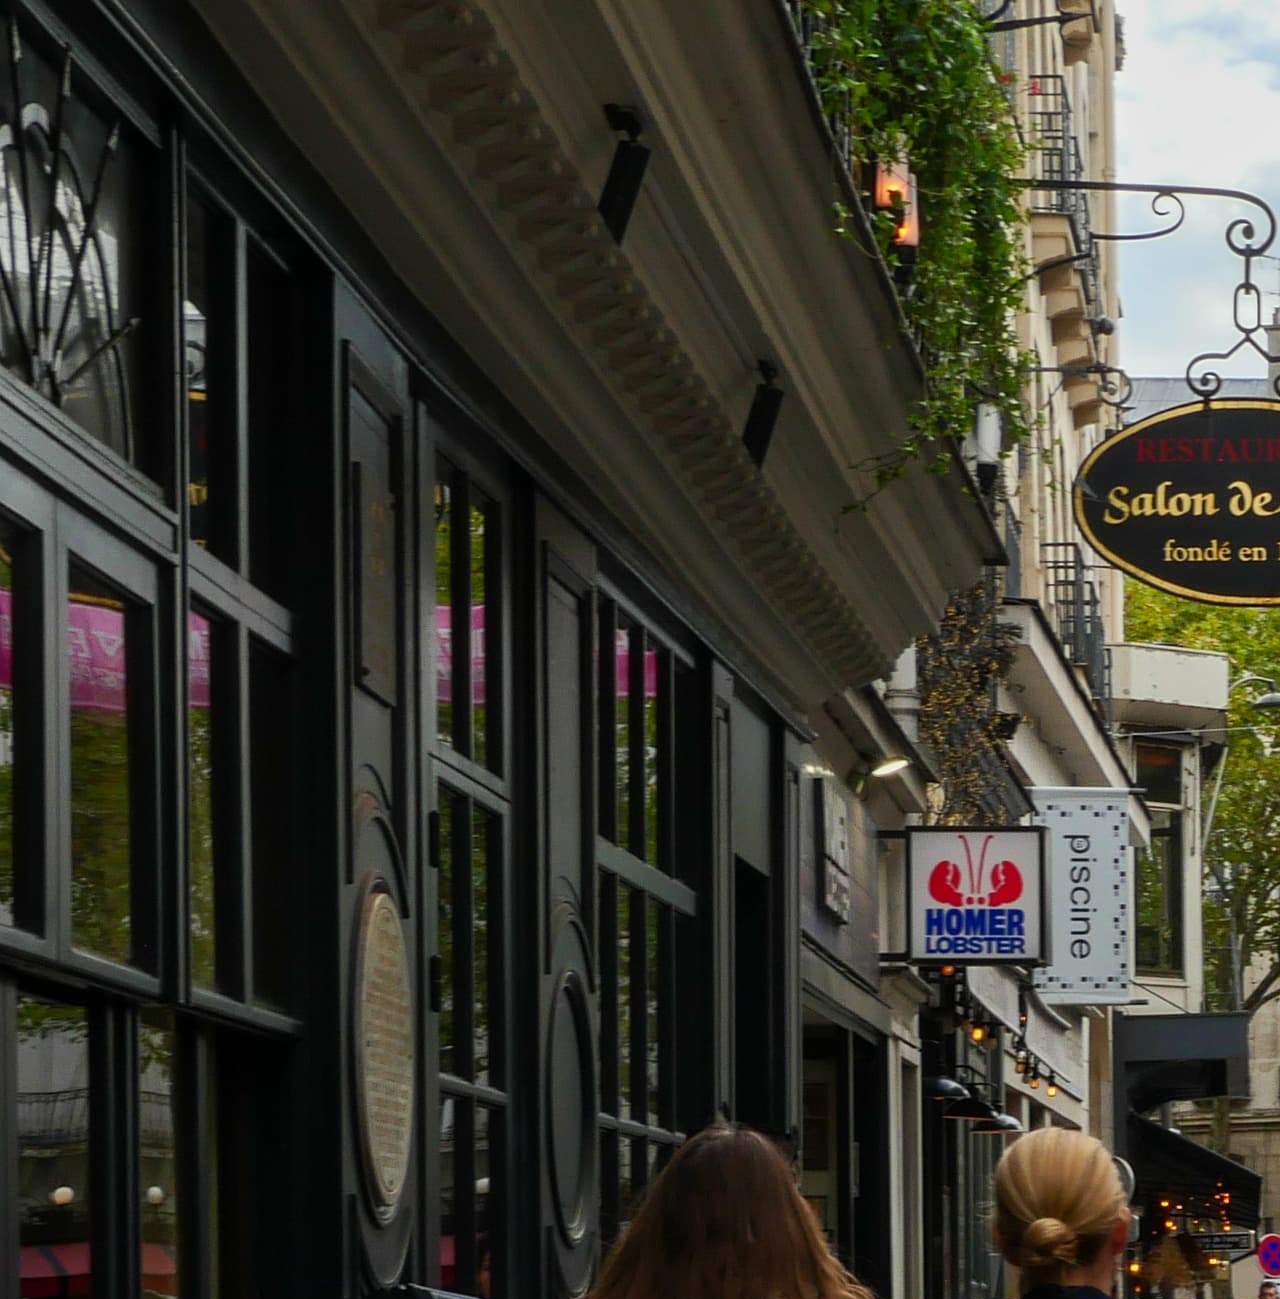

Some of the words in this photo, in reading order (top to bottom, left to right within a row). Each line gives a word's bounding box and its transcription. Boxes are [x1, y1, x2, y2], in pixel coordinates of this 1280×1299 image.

[1103, 481, 1221, 525] Salon
[1162, 539, 1232, 562] fondé
[1239, 544, 1267, 562] en
[1063, 834, 1098, 960] piscine
[925, 908, 1025, 936] HOMER
[925, 936, 1025, 954] LOBSTER
